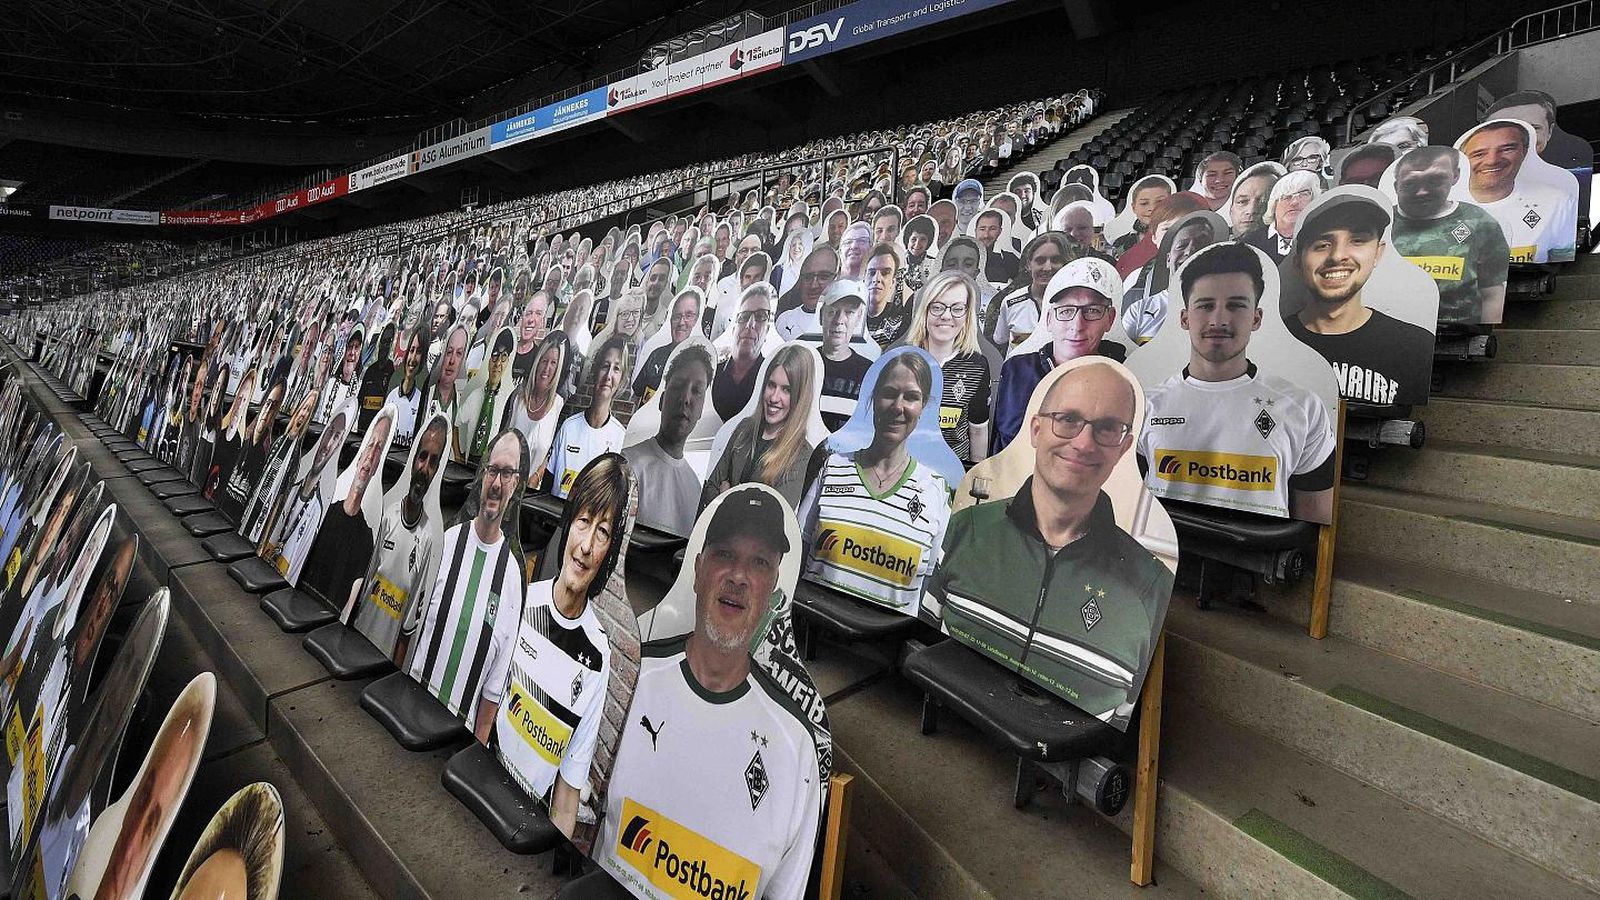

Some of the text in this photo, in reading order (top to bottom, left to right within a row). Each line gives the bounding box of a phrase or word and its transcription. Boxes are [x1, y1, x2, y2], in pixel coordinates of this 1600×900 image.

[853, 21, 874, 35] Global
[876, 12, 911, 29] Transport
[913, 5, 927, 17] and
[789, 17, 845, 54] DSV
[651, 61, 724, 88] Your Project Partner
[420, 134, 486, 166] ASG Aluminium
[287, 195, 299, 208] Audi
[321, 183, 336, 197] Audi
[56, 207, 114, 220] netpoint
[1419, 263, 1459, 275] bank
[1151, 417, 1185, 426] Kappa
[1188, 461, 1272, 484] Postbank
[842, 537, 916, 578] Postbank
[521, 710, 565, 760] Postbank
[654, 839, 749, 900] Postbank
